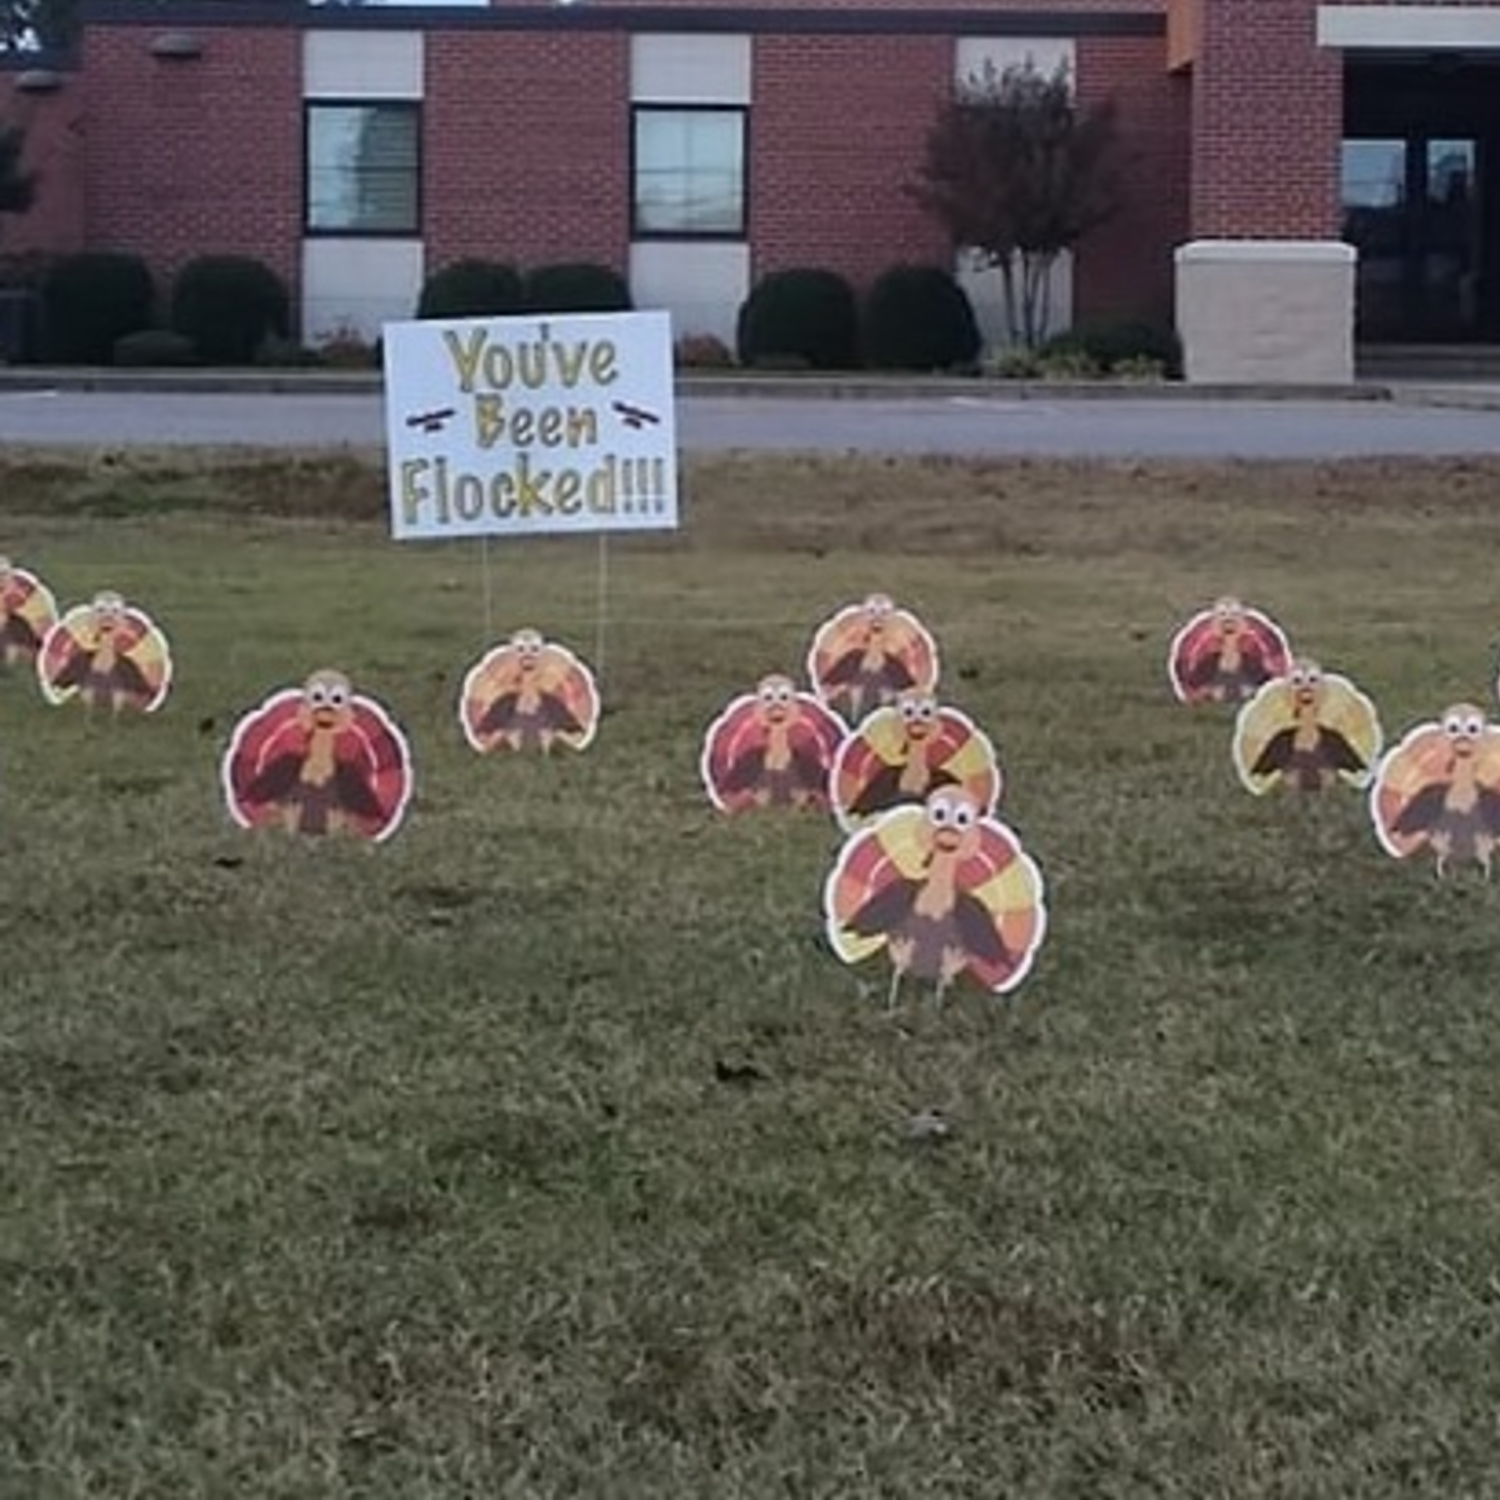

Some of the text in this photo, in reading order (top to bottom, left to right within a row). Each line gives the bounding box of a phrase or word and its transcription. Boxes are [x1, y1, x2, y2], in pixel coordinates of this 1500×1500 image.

[443, 323, 619, 393] You've
[475, 393, 598, 448] Been
[400, 452, 664, 525] Flocked!!!
